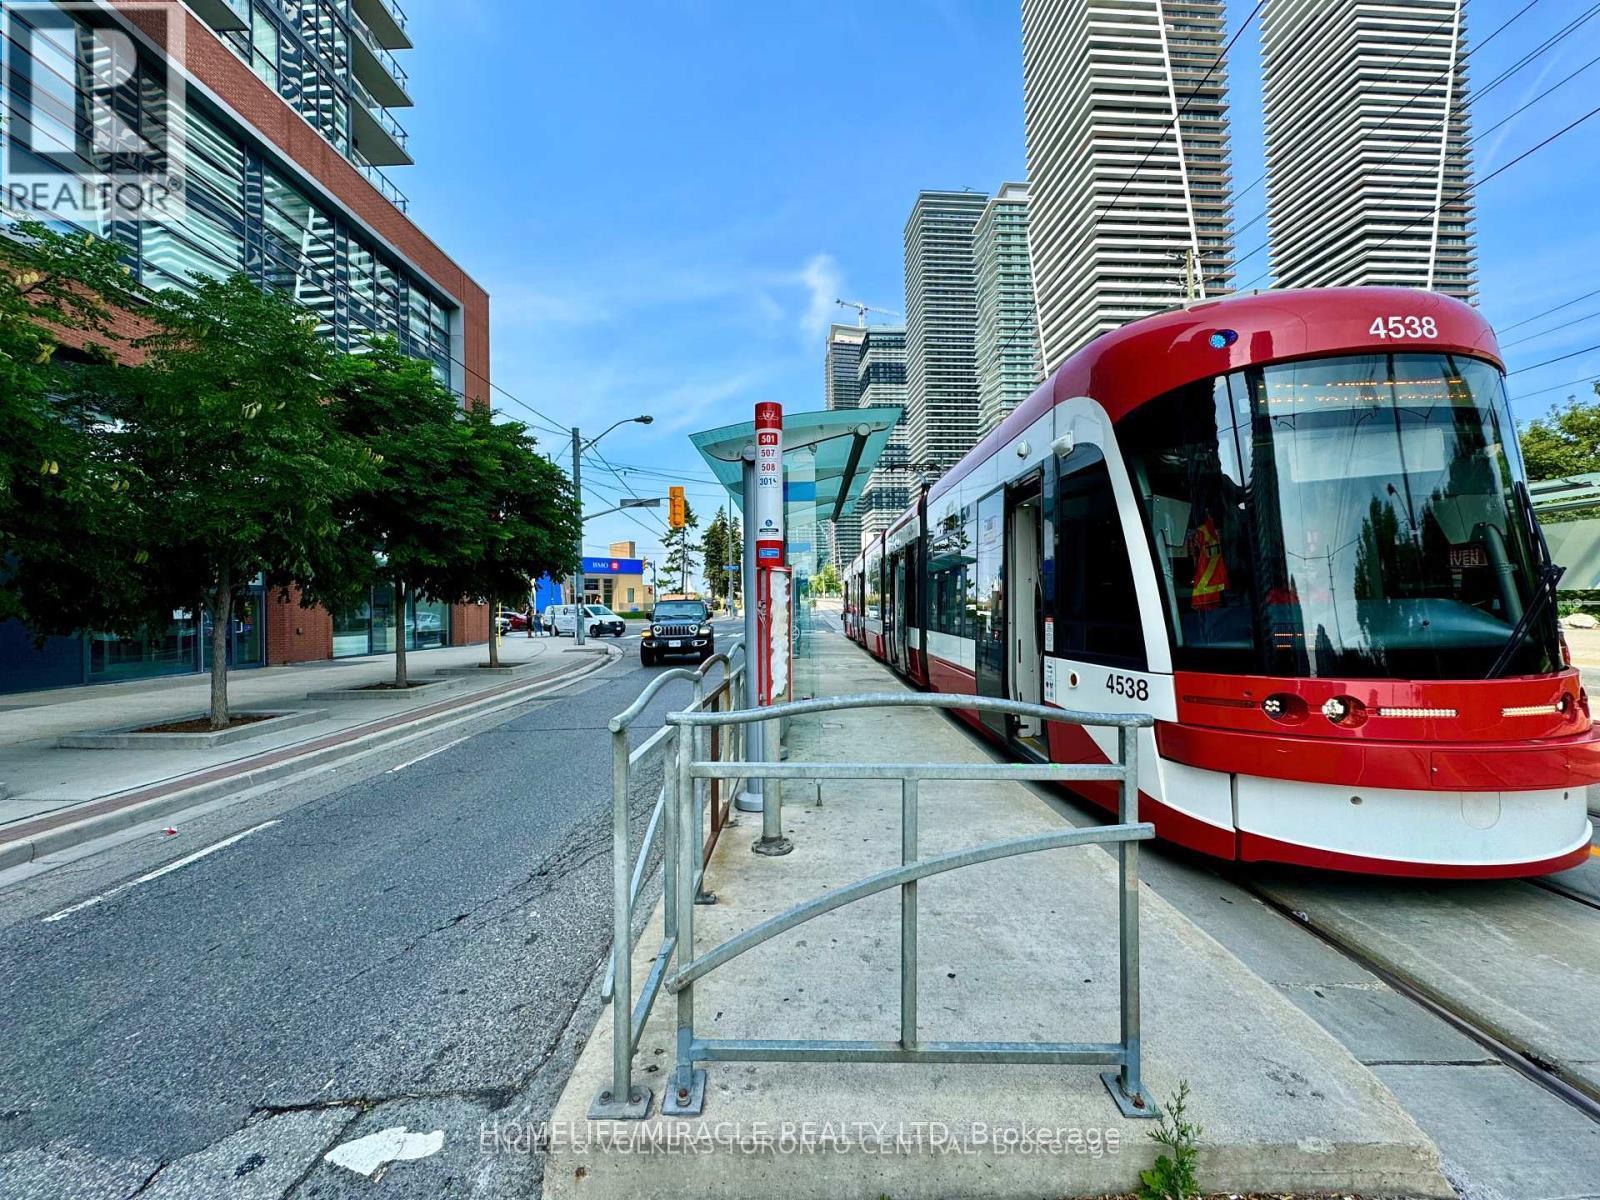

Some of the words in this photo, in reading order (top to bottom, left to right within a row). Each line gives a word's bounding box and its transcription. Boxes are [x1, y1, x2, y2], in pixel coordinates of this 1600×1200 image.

[1369, 316, 1438, 339] 4538
[761, 434, 775, 444] 501
[761, 449, 775, 458] 507
[761, 463, 776, 472] 508
[759, 477, 773, 486] 301
[1106, 673, 1149, 702] 4538
